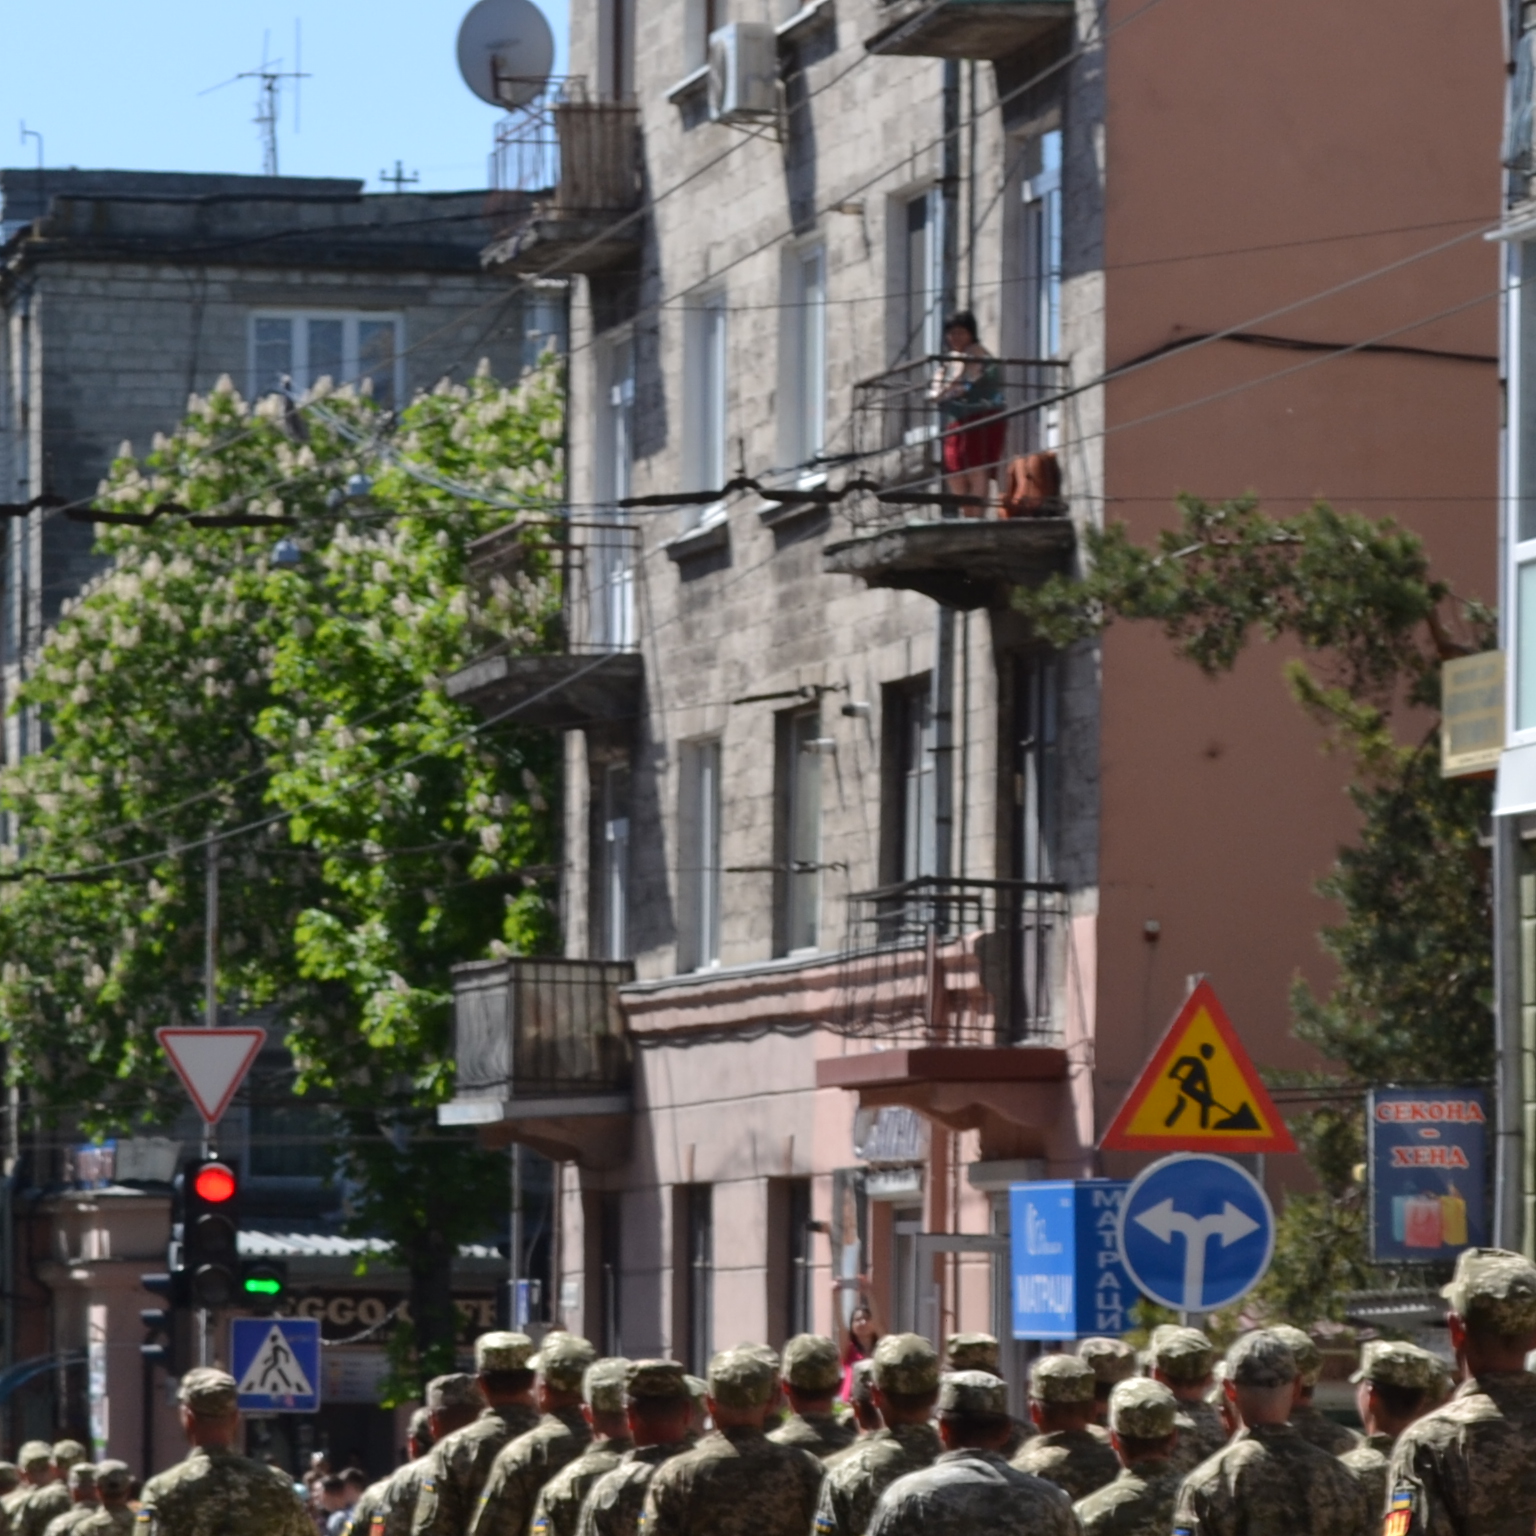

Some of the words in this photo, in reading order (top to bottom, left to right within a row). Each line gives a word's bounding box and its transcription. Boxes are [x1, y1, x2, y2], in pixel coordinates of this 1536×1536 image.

[1375, 1101, 1486, 1123] СЕКОНД
[1391, 1145, 1470, 1170] ХЕНД
[1092, 1189, 1125, 1331] МАТРАЦИ
[1016, 1274, 1074, 1321] МАТРАЦИ
